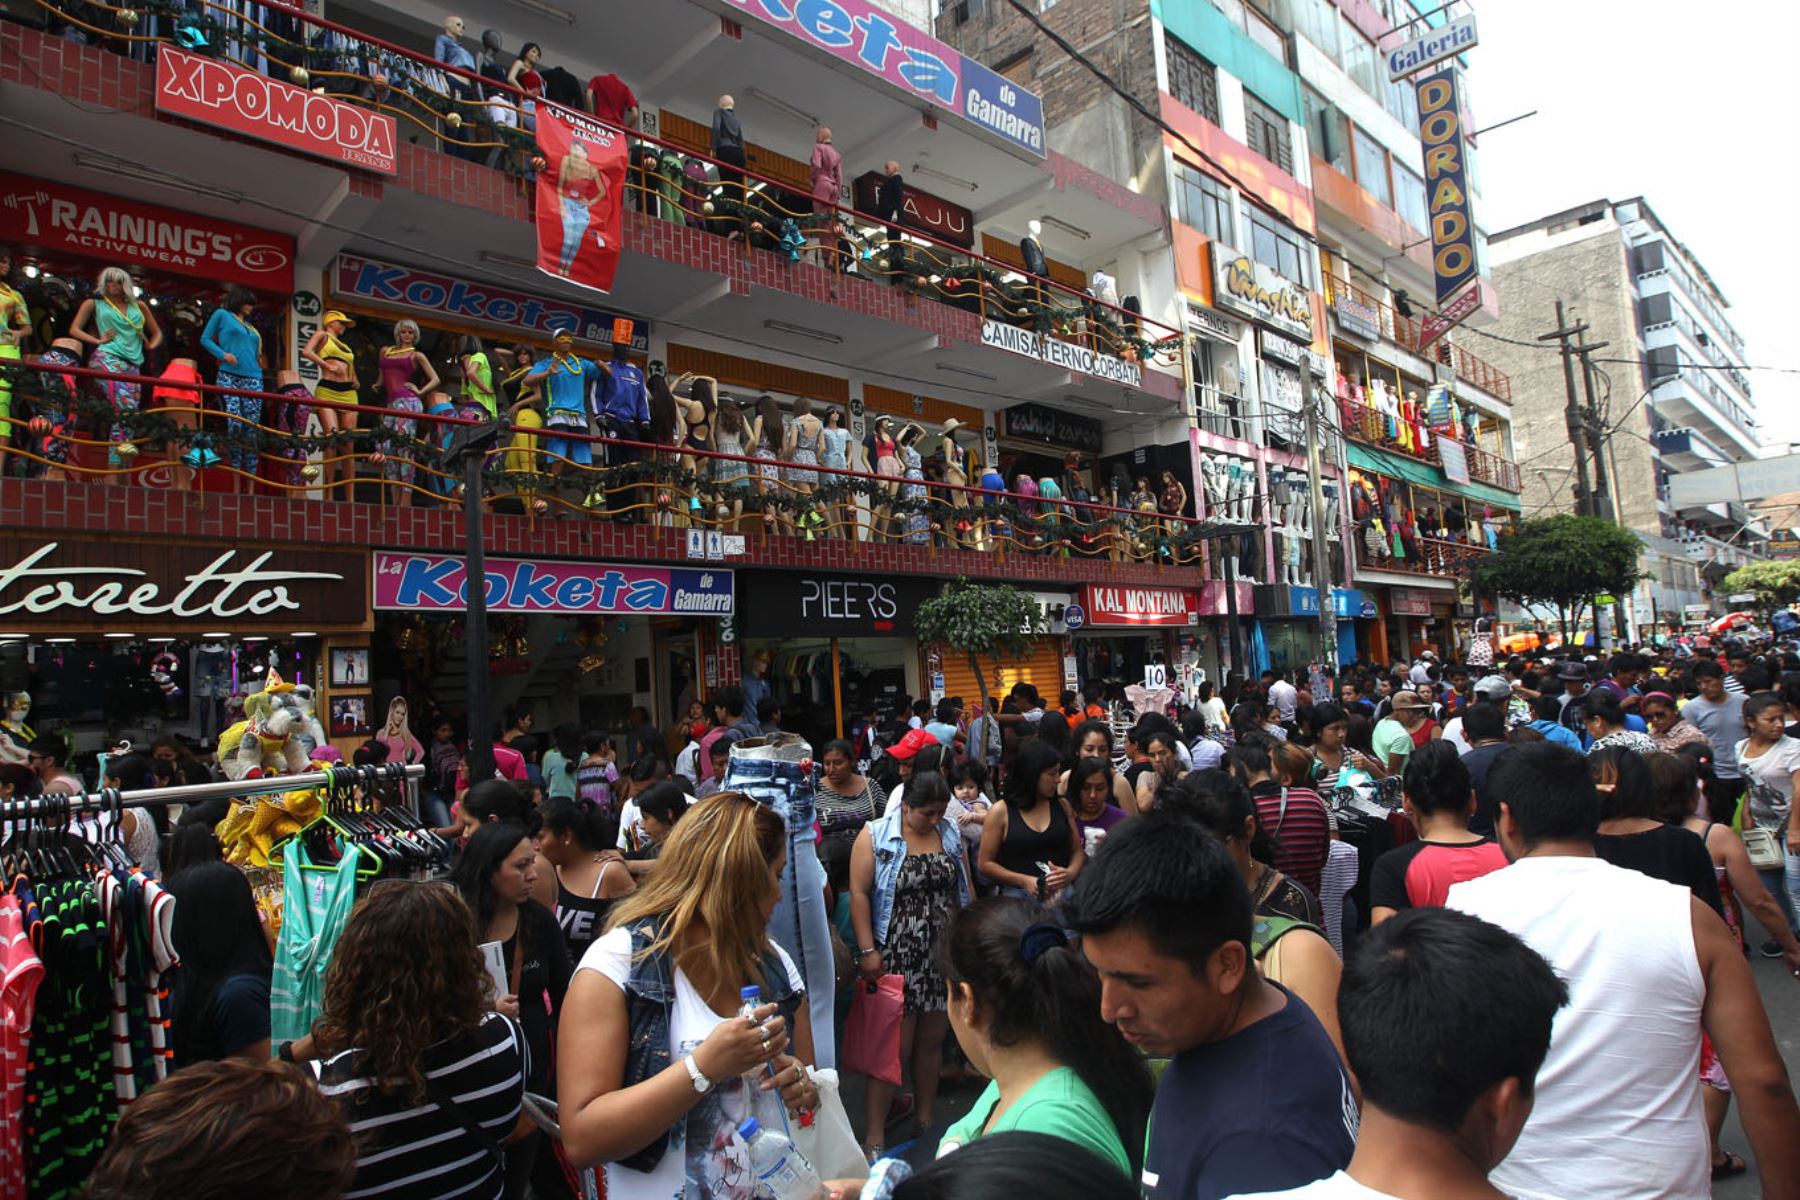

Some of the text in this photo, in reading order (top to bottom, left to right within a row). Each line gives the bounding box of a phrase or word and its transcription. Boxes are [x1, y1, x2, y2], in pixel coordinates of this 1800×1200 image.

[1390, 24, 1474, 74] Galeria
[162, 48, 394, 159] XPOMODA
[1000, 84, 1016, 108] de
[544, 105, 617, 141] XPOMODA
[966, 87, 1042, 150] Gamarra
[342, 147, 391, 171] JEANS
[1418, 78, 1473, 278] DORADO
[64, 232, 197, 268] ACTIVEWEAR
[340, 254, 359, 273] La
[354, 262, 584, 338] Koketa
[586, 321, 648, 350] Gamra
[981, 320, 1142, 387] CAMISA TERNO CORBATA
[378, 555, 670, 612] La Koketa
[699, 572, 714, 589] de
[673, 588, 733, 612] Gamarra
[801, 580, 898, 619] PIEERS
[1093, 588, 1188, 614] KAL MONTANA
[1066, 614, 1082, 624] VISA
[1149, 665, 1164, 686] 10
[556, 905, 595, 941] VE
